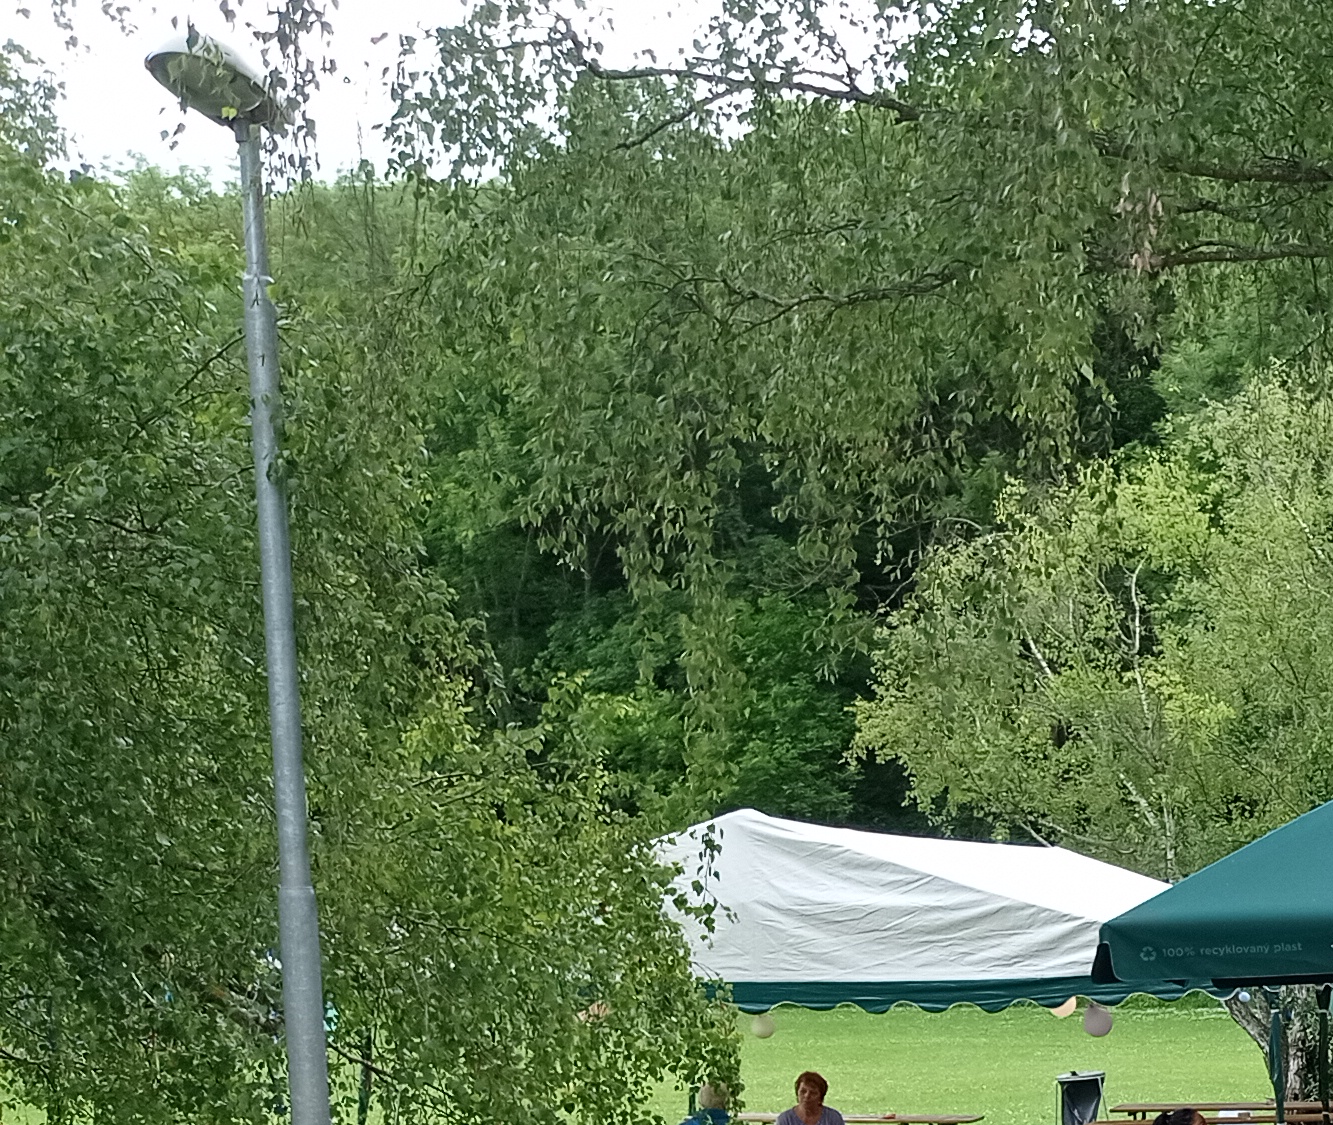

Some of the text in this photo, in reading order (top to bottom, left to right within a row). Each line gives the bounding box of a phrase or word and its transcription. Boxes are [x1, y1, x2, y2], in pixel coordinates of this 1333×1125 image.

[1162, 942, 1302, 957] 100% recyklovaný plast
